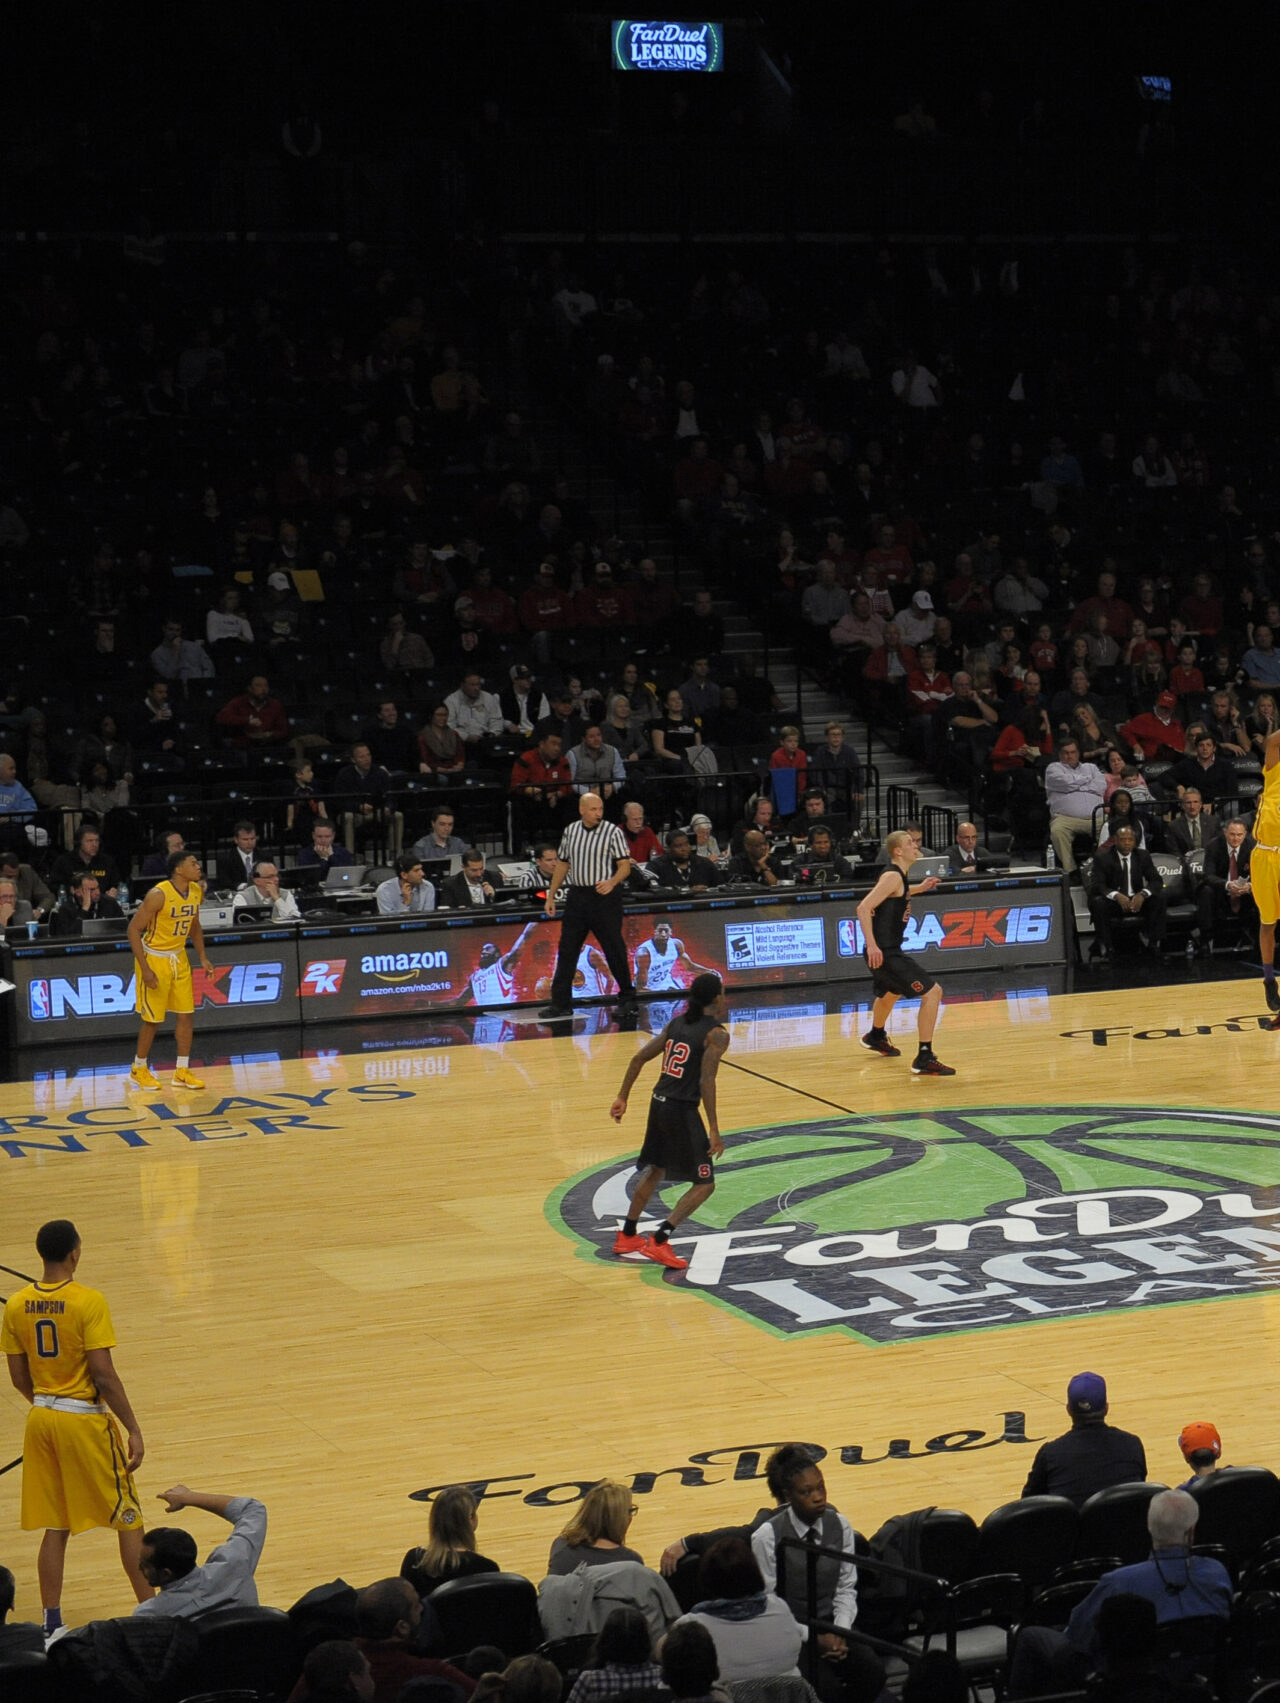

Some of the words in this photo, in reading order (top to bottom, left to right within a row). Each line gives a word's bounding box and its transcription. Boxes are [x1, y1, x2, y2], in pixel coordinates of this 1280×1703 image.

[629, 23, 708, 43] FanDuel
[631, 43, 707, 62] LEGENDS
[637, 59, 701, 70] CLASSIC
[1157, 865, 1183, 877] Duel
[170, 904, 200, 919] LSU
[172, 920, 191, 936] 15
[755, 925, 775, 933] Alcohol
[777, 924, 804, 932] Reference
[756, 935, 768, 943] Mild
[769, 934, 796, 943] Language
[769, 943, 799, 952] Suggestive
[800, 941, 821, 949] Themes
[361, 950, 449, 974] amazon
[756, 954, 775, 962] Violent
[777, 952, 808, 960] References
[303, 962, 340, 994] 2K
[360, 981, 452, 996] amazon.com/nba2k16
[479, 980, 487, 995] 13
[661, 1038, 691, 1079] 12
[24, 1300, 65, 1315] SAMPSON
[35, 1318, 61, 1359] 0
